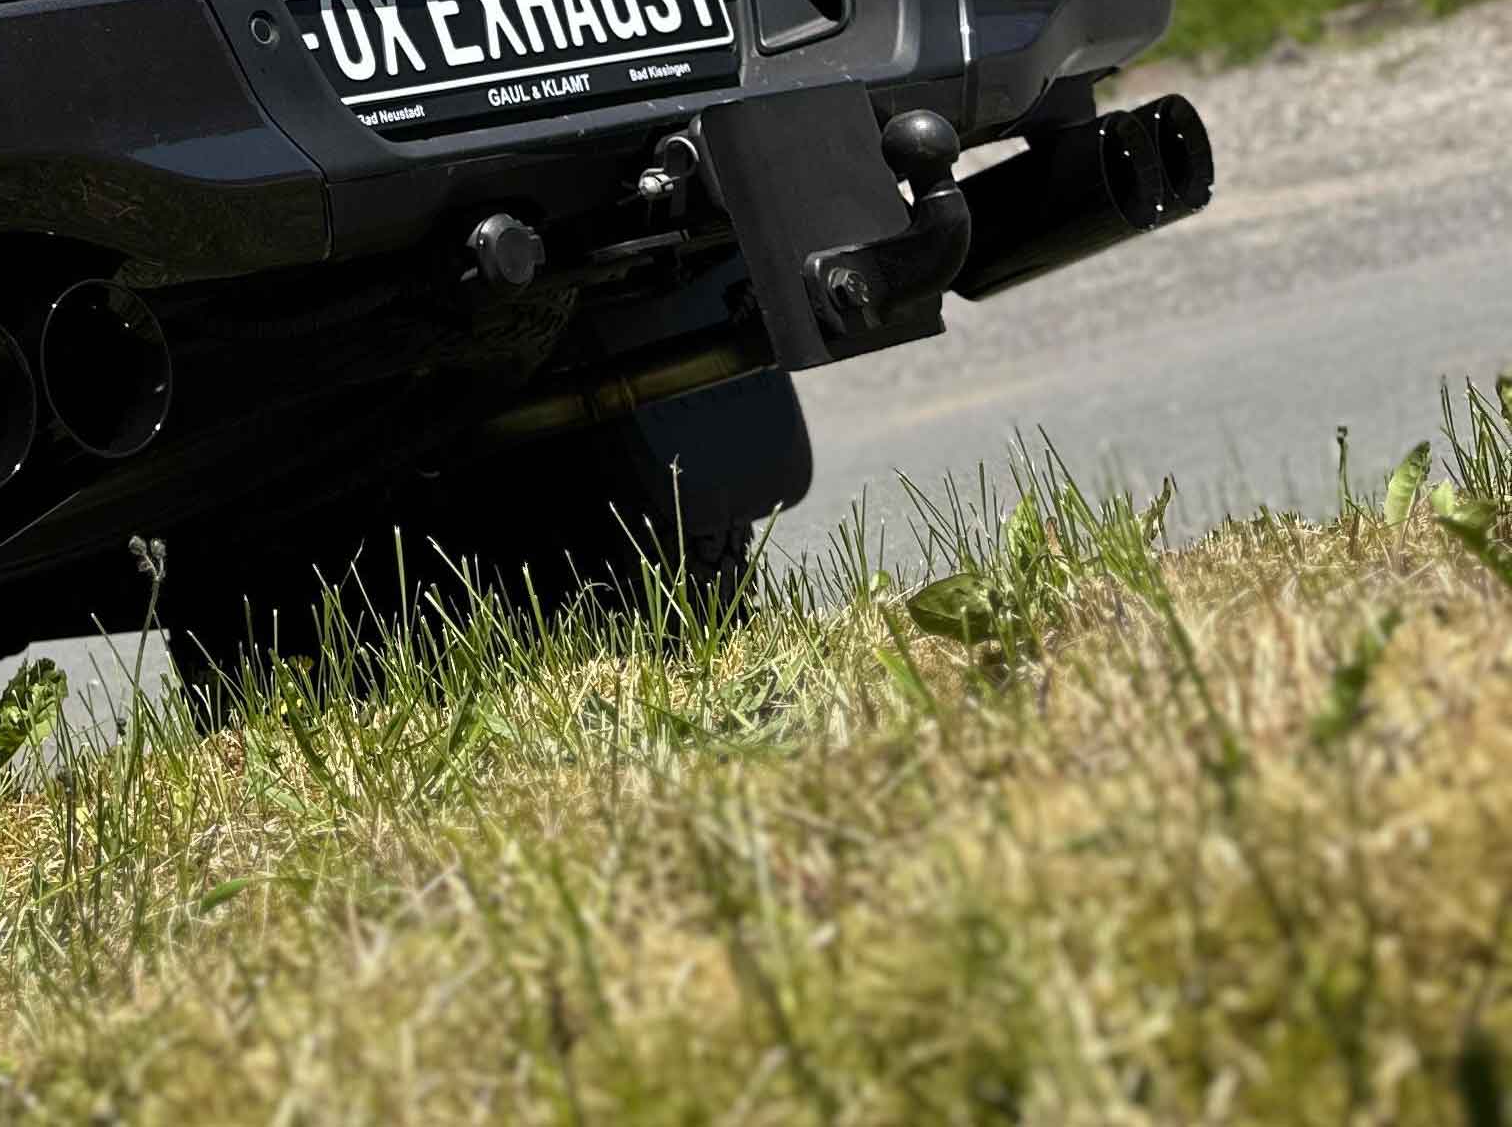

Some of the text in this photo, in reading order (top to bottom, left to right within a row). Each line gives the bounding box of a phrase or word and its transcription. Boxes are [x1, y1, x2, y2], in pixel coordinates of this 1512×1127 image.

[379, 104, 426, 124] Neustadt
[488, 84, 531, 107] GAUL
[532, 85, 541, 99] &
[541, 74, 591, 98] KLAMT
[629, 68, 649, 82] Bad
[648, 62, 692, 79] Kissingen
